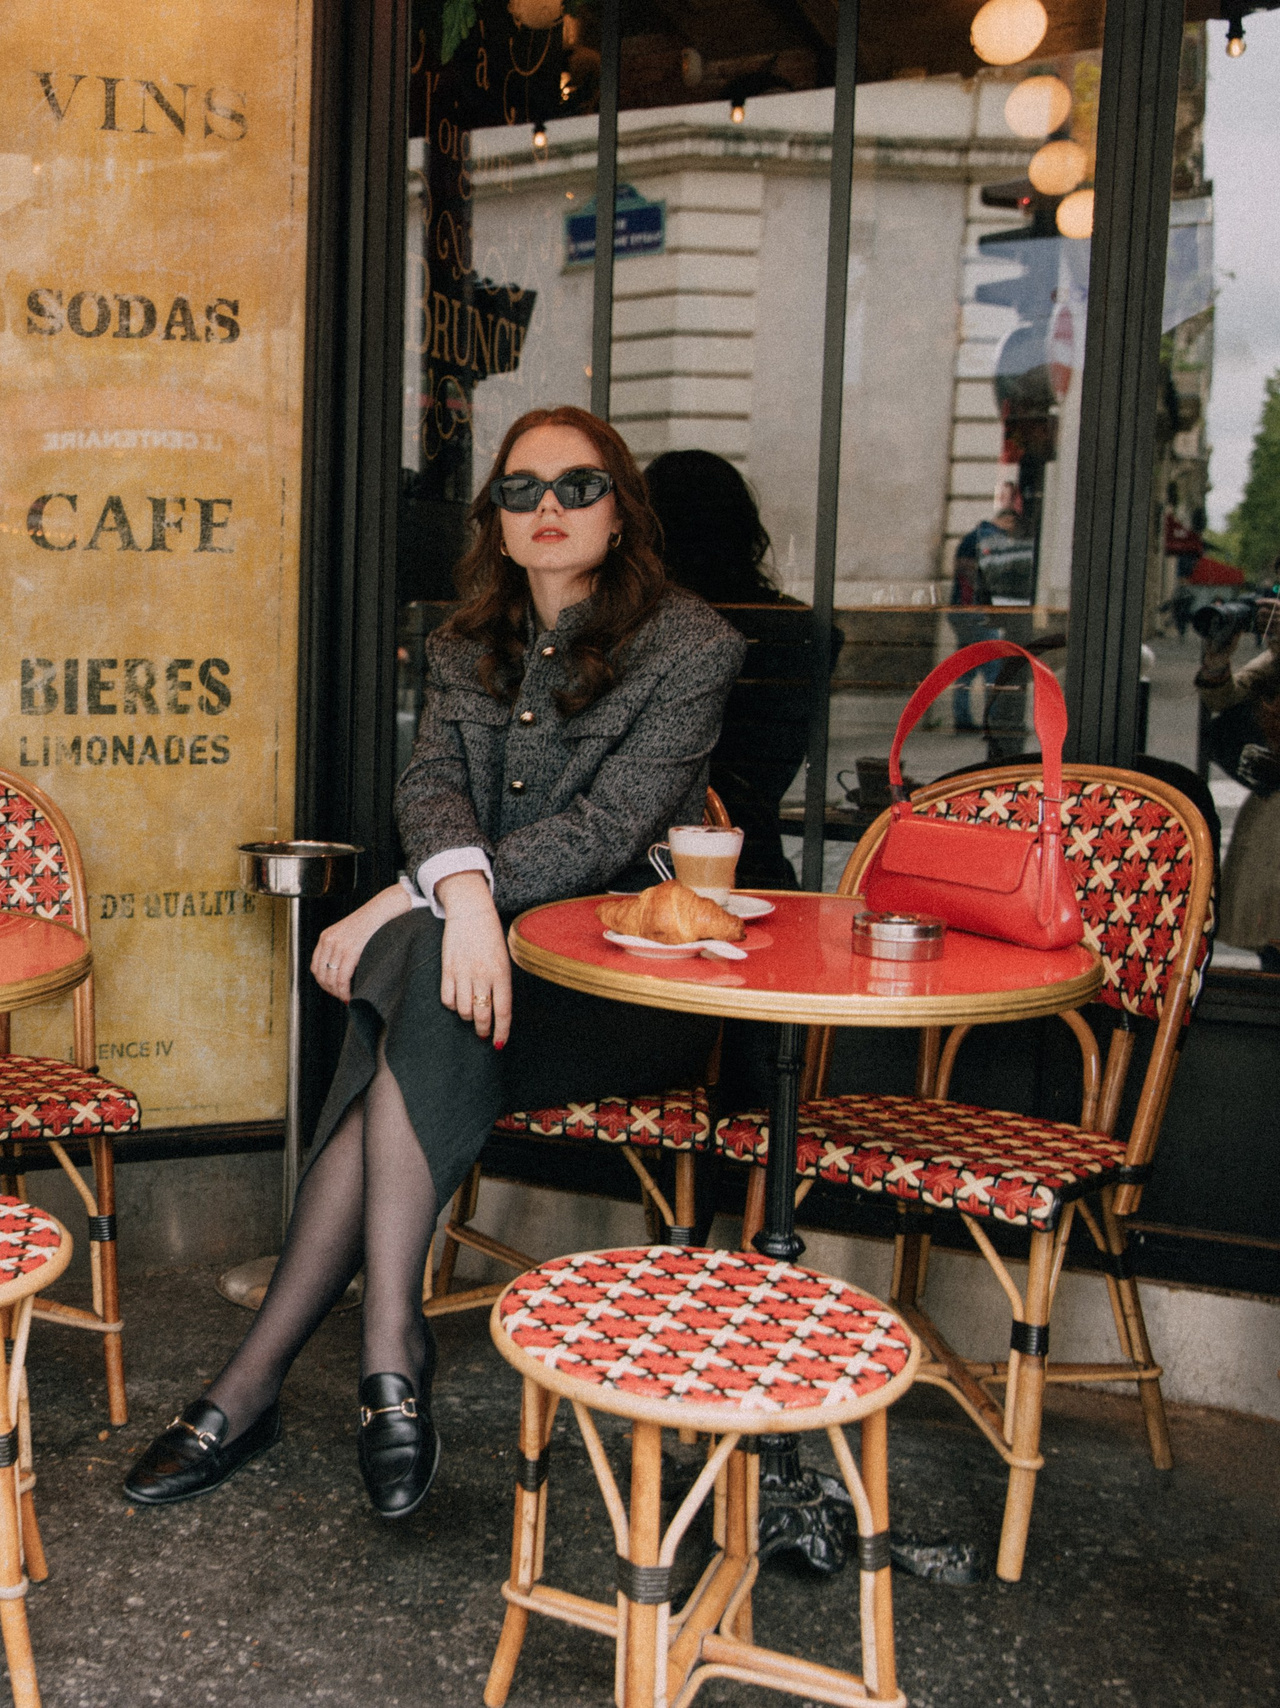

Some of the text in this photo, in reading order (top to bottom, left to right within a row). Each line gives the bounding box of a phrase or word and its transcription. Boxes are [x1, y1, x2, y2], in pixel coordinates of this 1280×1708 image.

[31, 70, 248, 142] VINS
[26, 287, 241, 345] SODAS
[26, 492, 234, 553] CAFE
[20, 657, 232, 716] BIERES
[19, 734, 231, 767] LIMONADES
[100, 893, 135, 920] DE
[155, 1040, 174, 1057] IV
